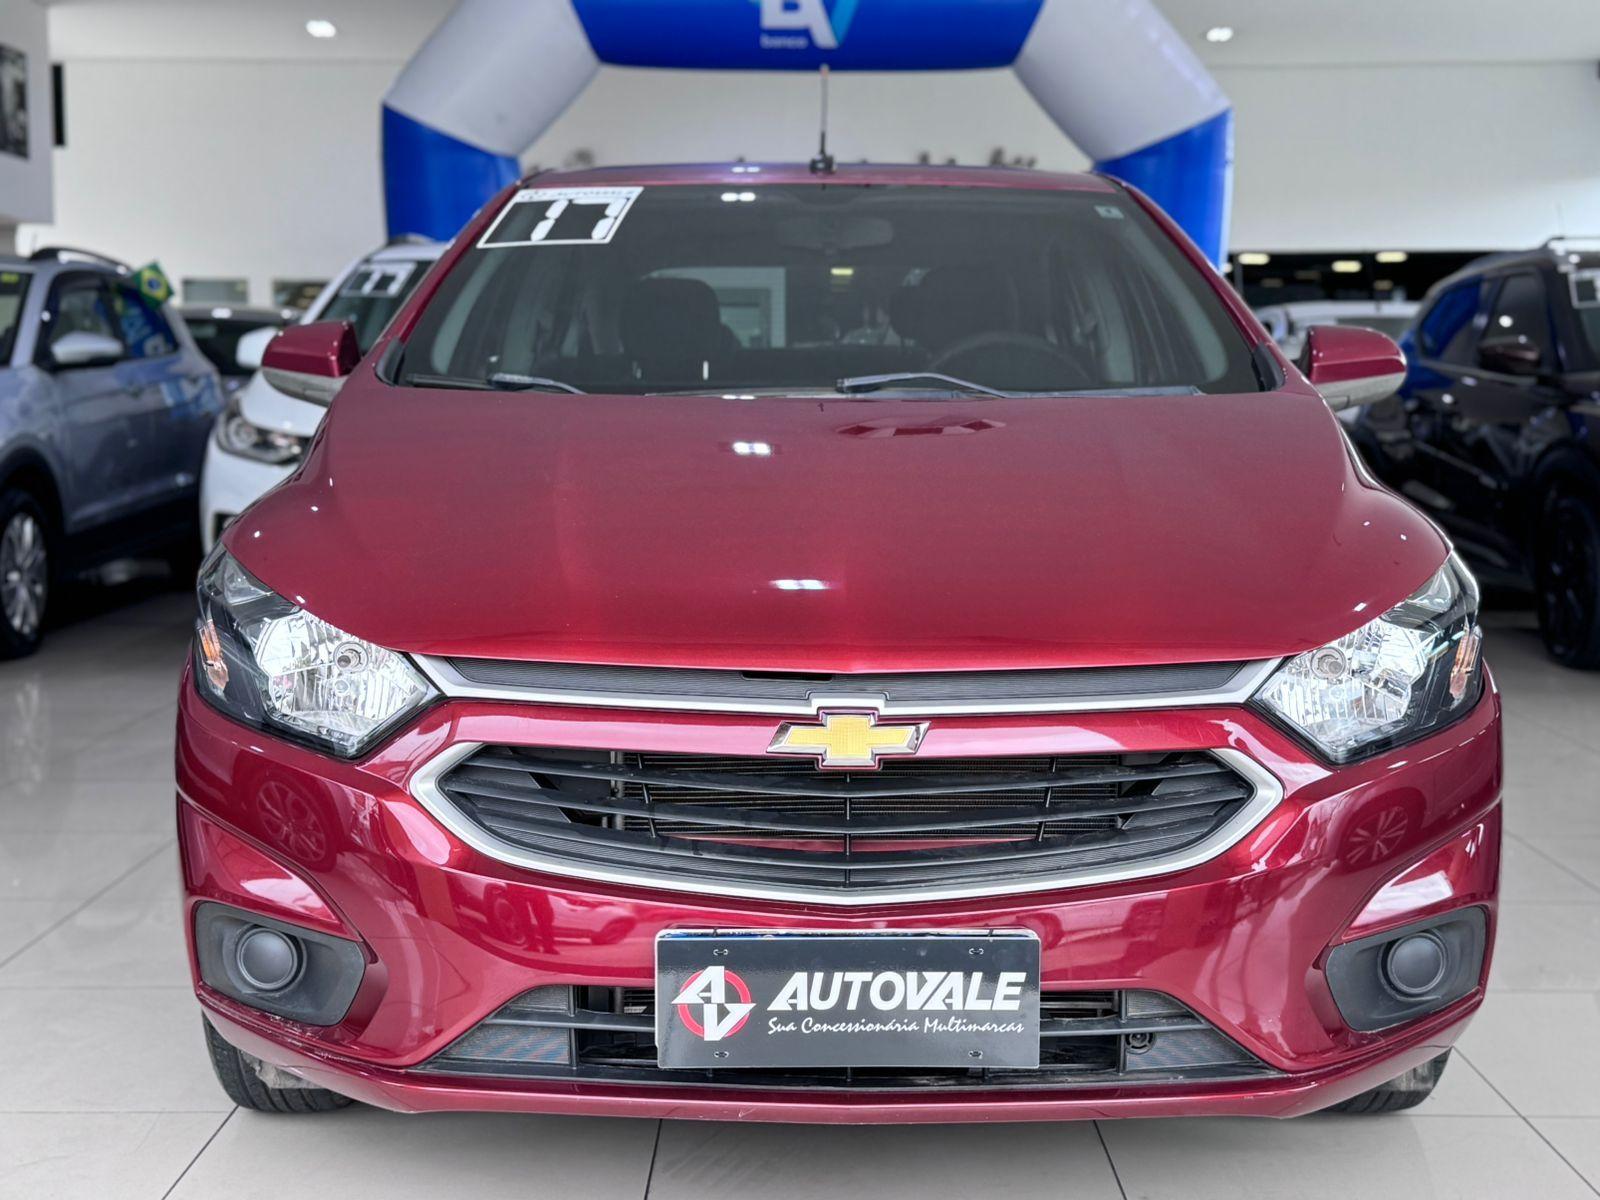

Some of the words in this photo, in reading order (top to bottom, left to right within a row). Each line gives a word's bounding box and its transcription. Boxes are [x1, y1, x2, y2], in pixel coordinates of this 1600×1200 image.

[766, 971, 1027, 1011] AUTOVALE
[767, 1016, 798, 1035] Sua
[800, 1016, 920, 1034] Concessionária
[923, 1014, 1025, 1034] Multimarcas
